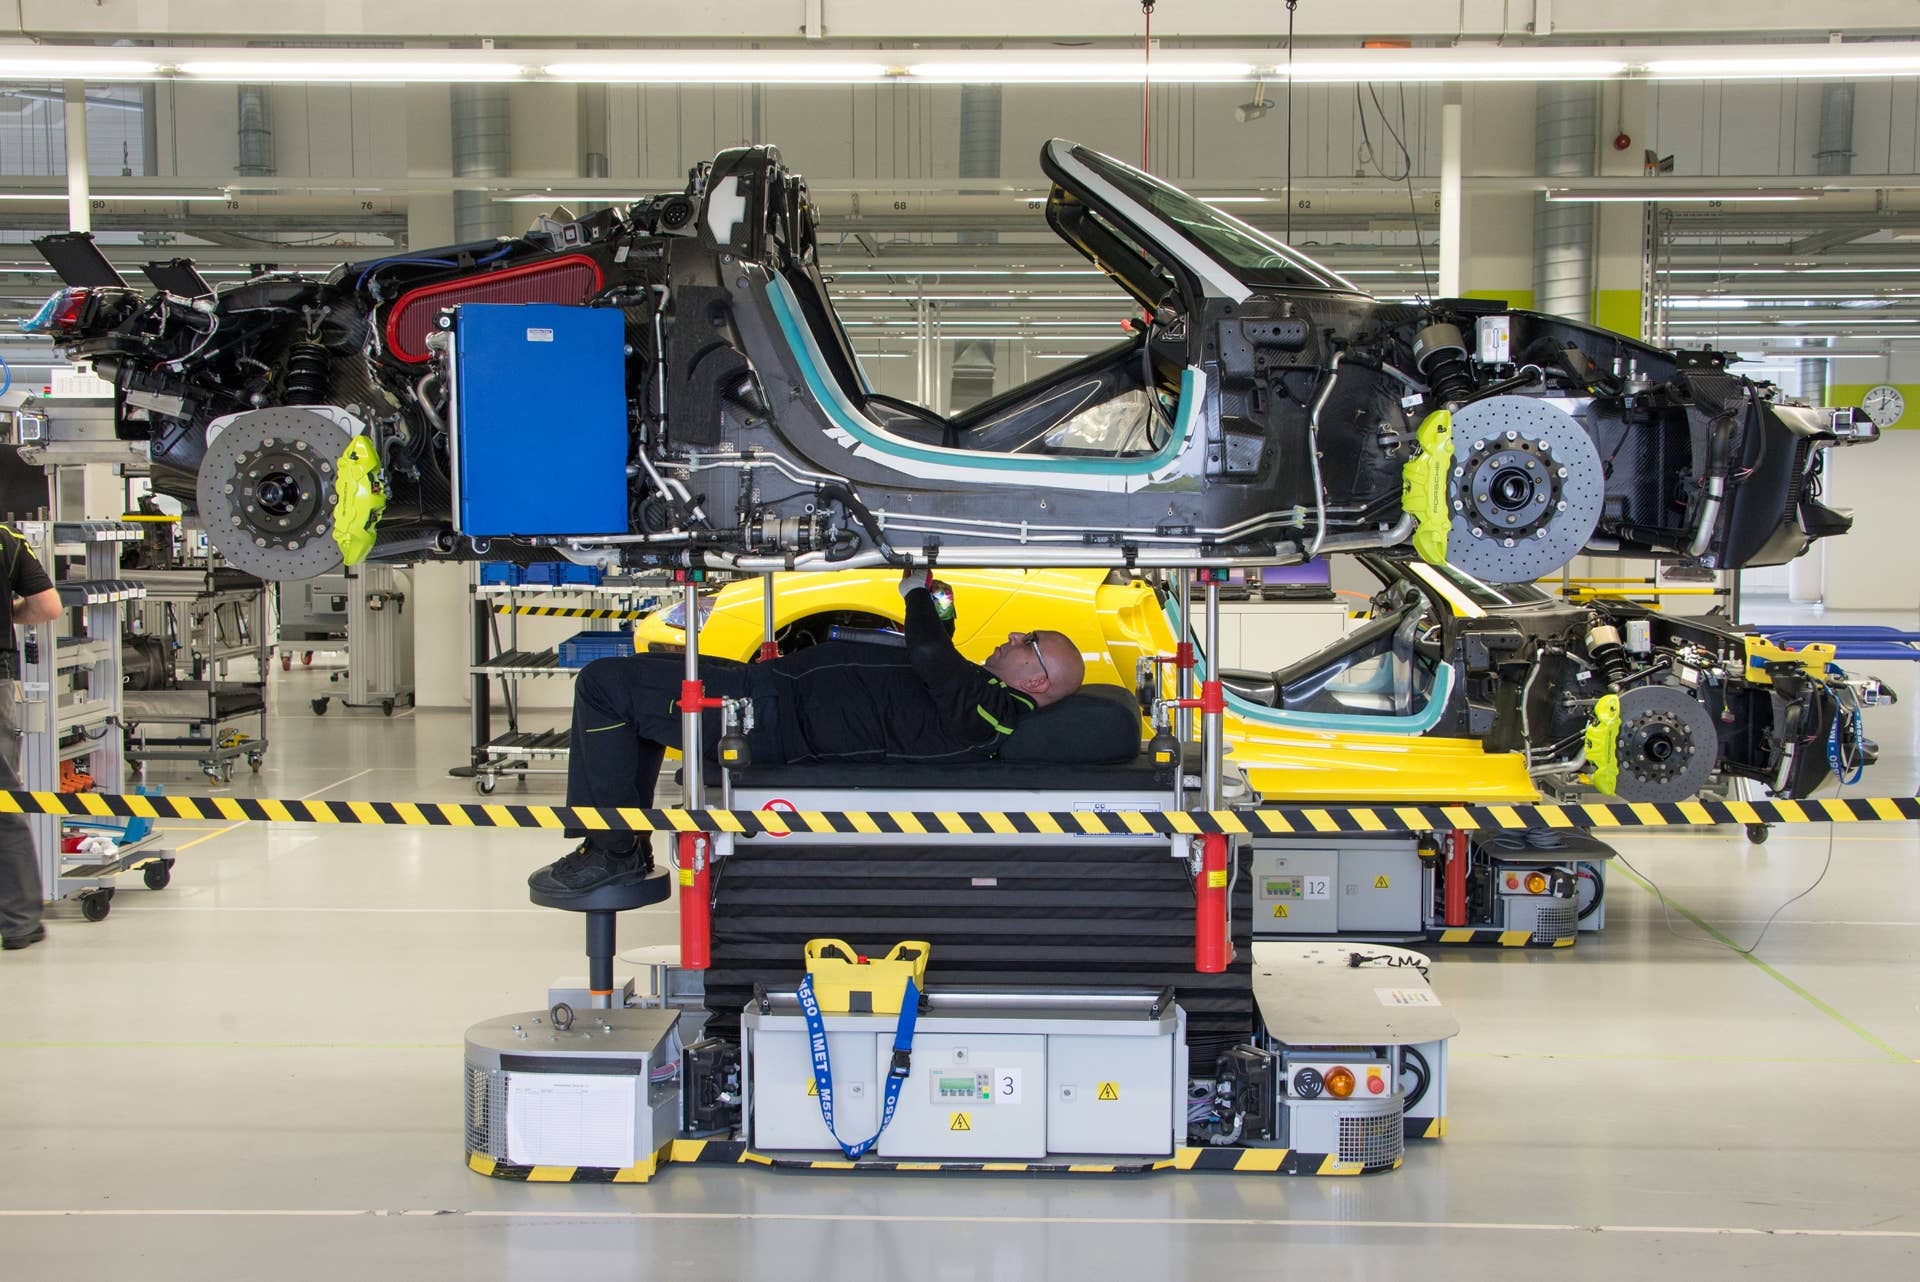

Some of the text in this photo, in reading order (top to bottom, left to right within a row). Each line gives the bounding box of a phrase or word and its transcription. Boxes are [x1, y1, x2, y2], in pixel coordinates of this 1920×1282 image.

[92, 200, 105, 208] 80
[227, 201, 239, 209] 78
[361, 202, 373, 210] 76
[894, 202, 906, 210] 68
[1028, 201, 1040, 209] 66
[1309, 881, 1325, 894] 12
[812, 1032, 828, 1072] IMET
[1003, 1076, 1013, 1095] 3
